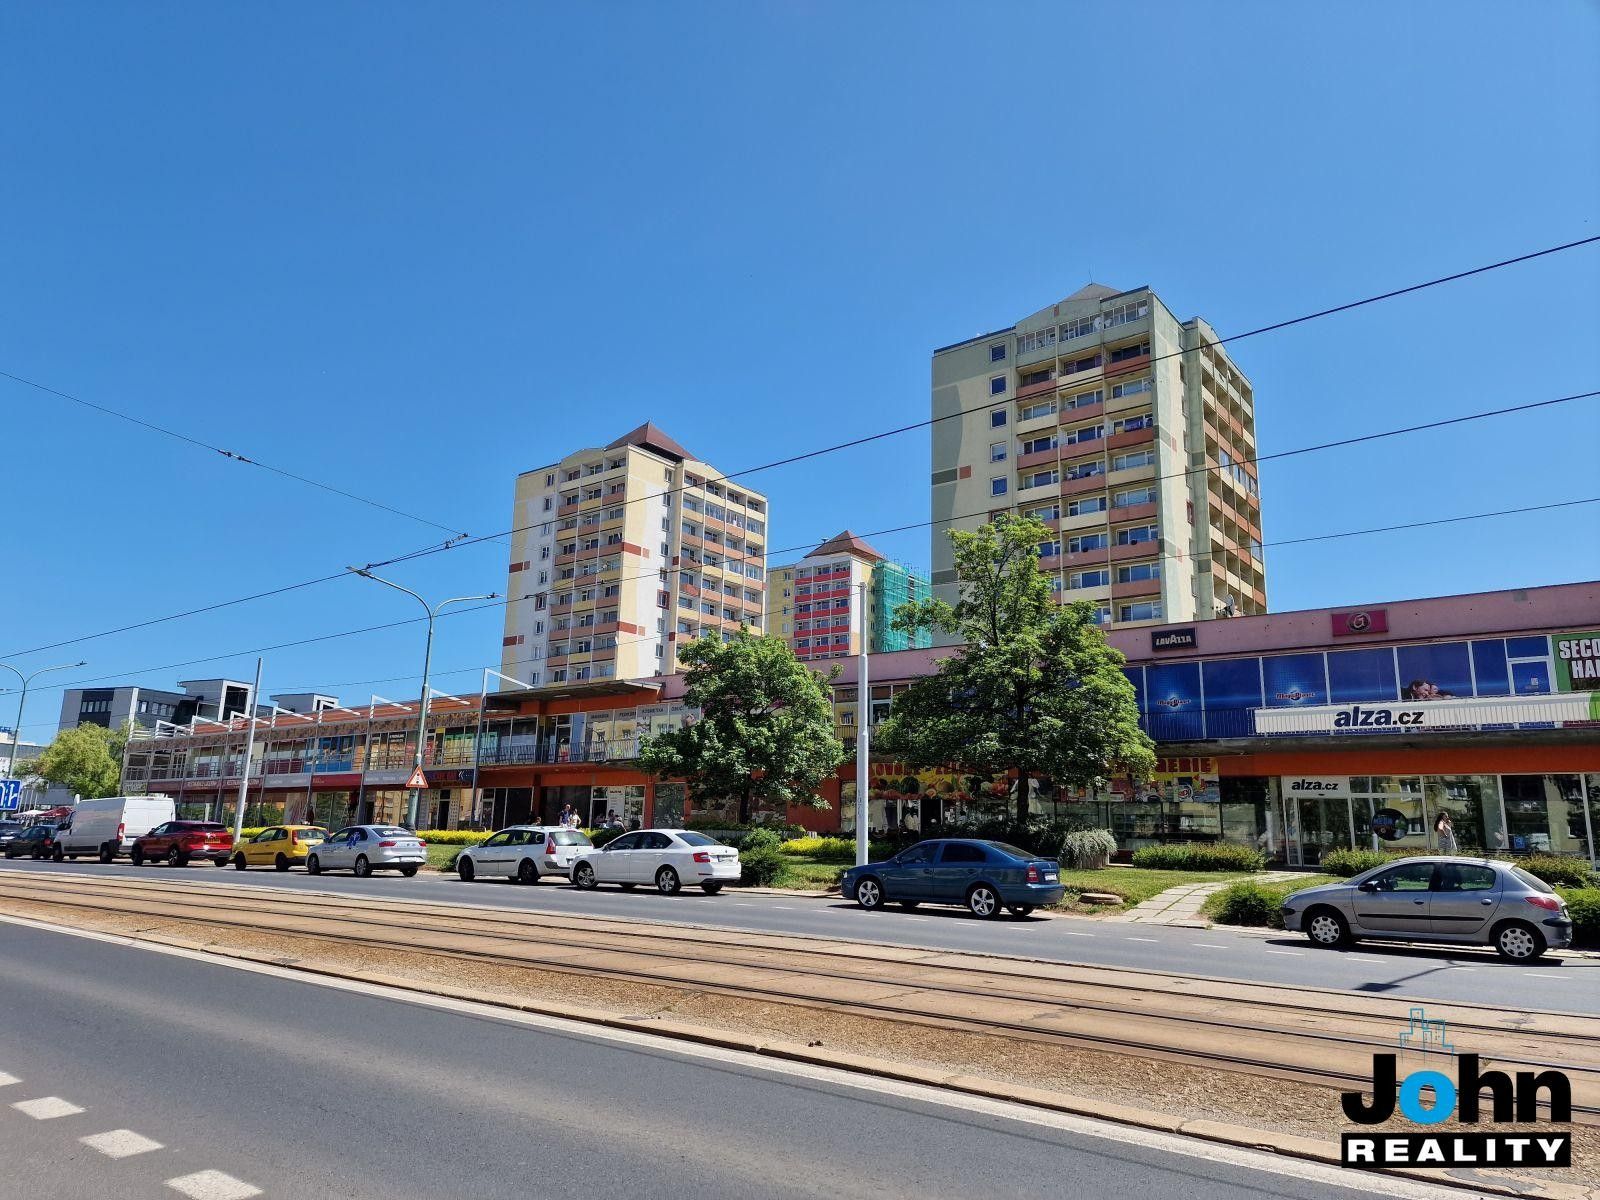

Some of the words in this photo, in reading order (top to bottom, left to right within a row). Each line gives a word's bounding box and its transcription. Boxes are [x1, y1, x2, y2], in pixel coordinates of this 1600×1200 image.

[1156, 634, 1192, 646] LAVAZZA
[1334, 706, 1424, 727] alza.cz
[1291, 779, 1339, 790] alza.cz
